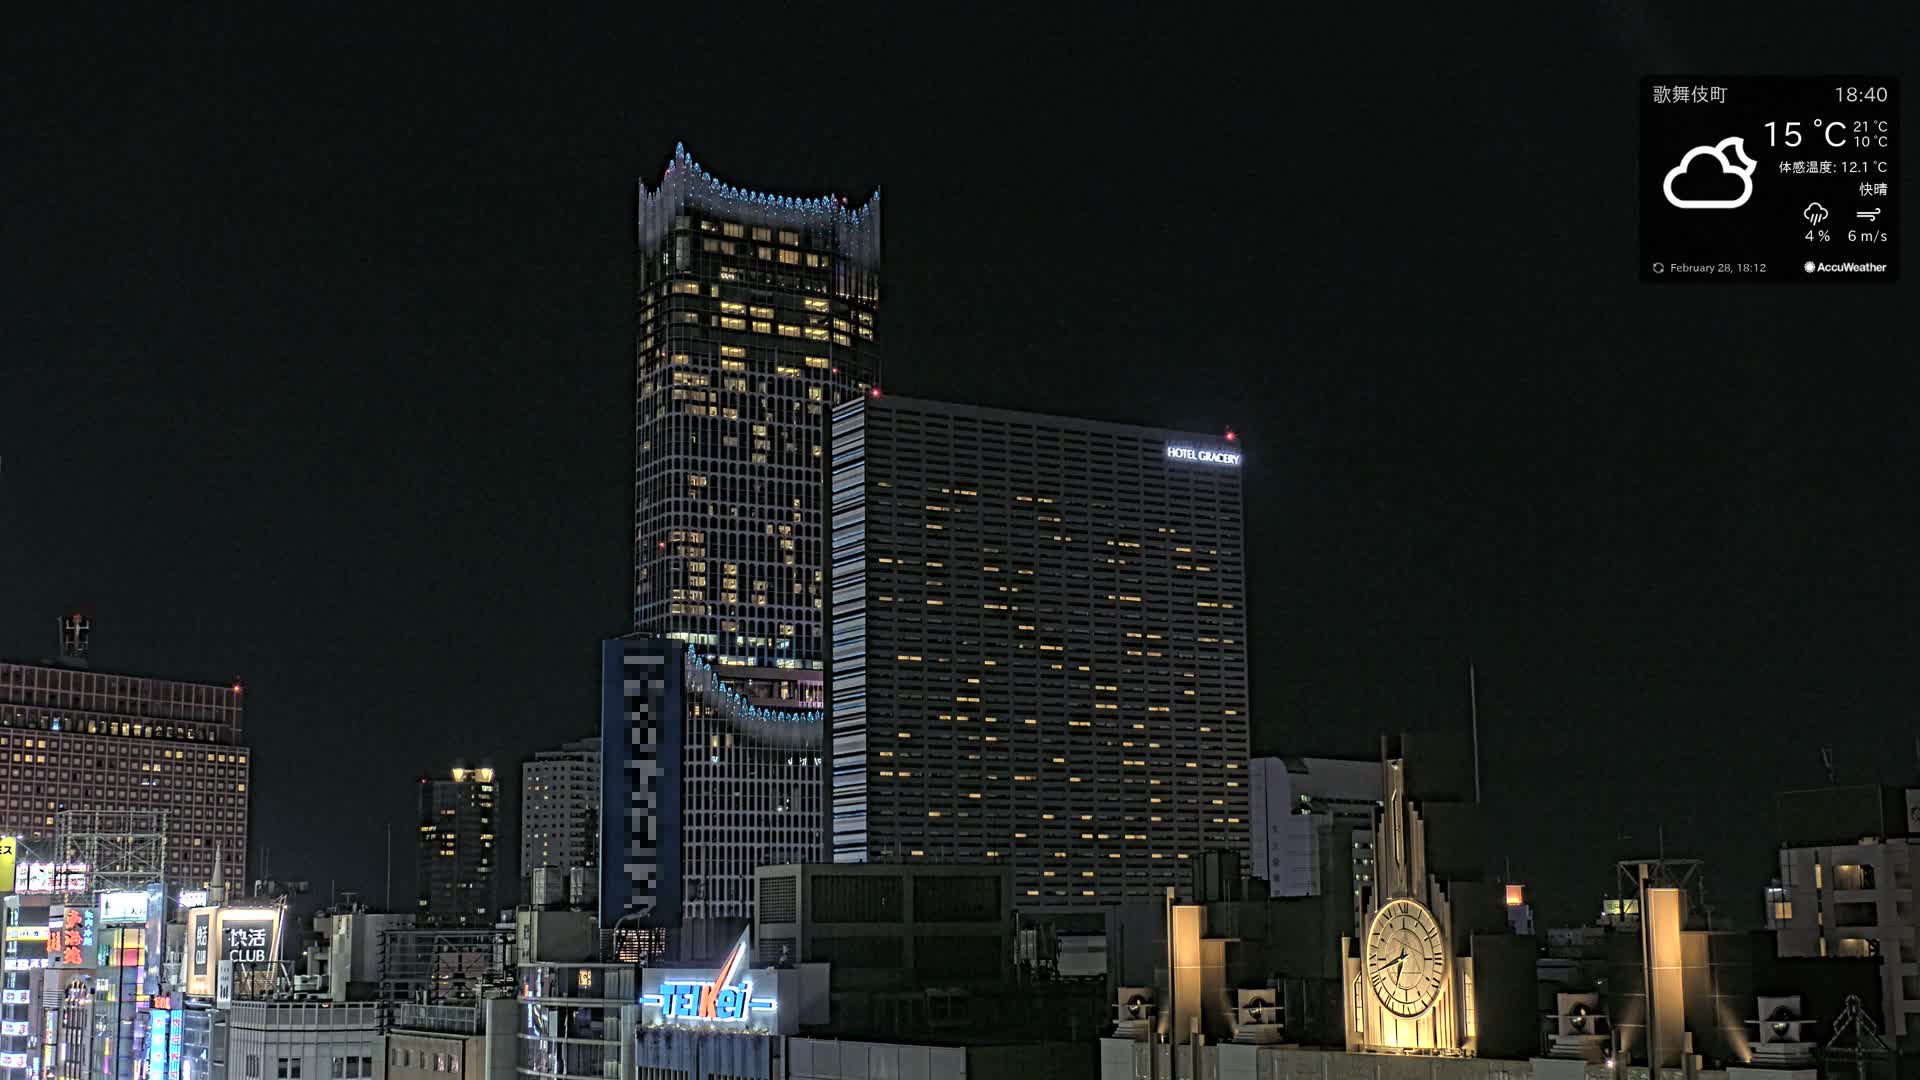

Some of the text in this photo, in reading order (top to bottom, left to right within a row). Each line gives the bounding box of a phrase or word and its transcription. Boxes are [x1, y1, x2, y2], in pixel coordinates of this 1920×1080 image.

[1167, 447, 1240, 465] HOTEL GRACERY
[229, 928, 267, 948] 快活
[229, 949, 266, 963] CLUB
